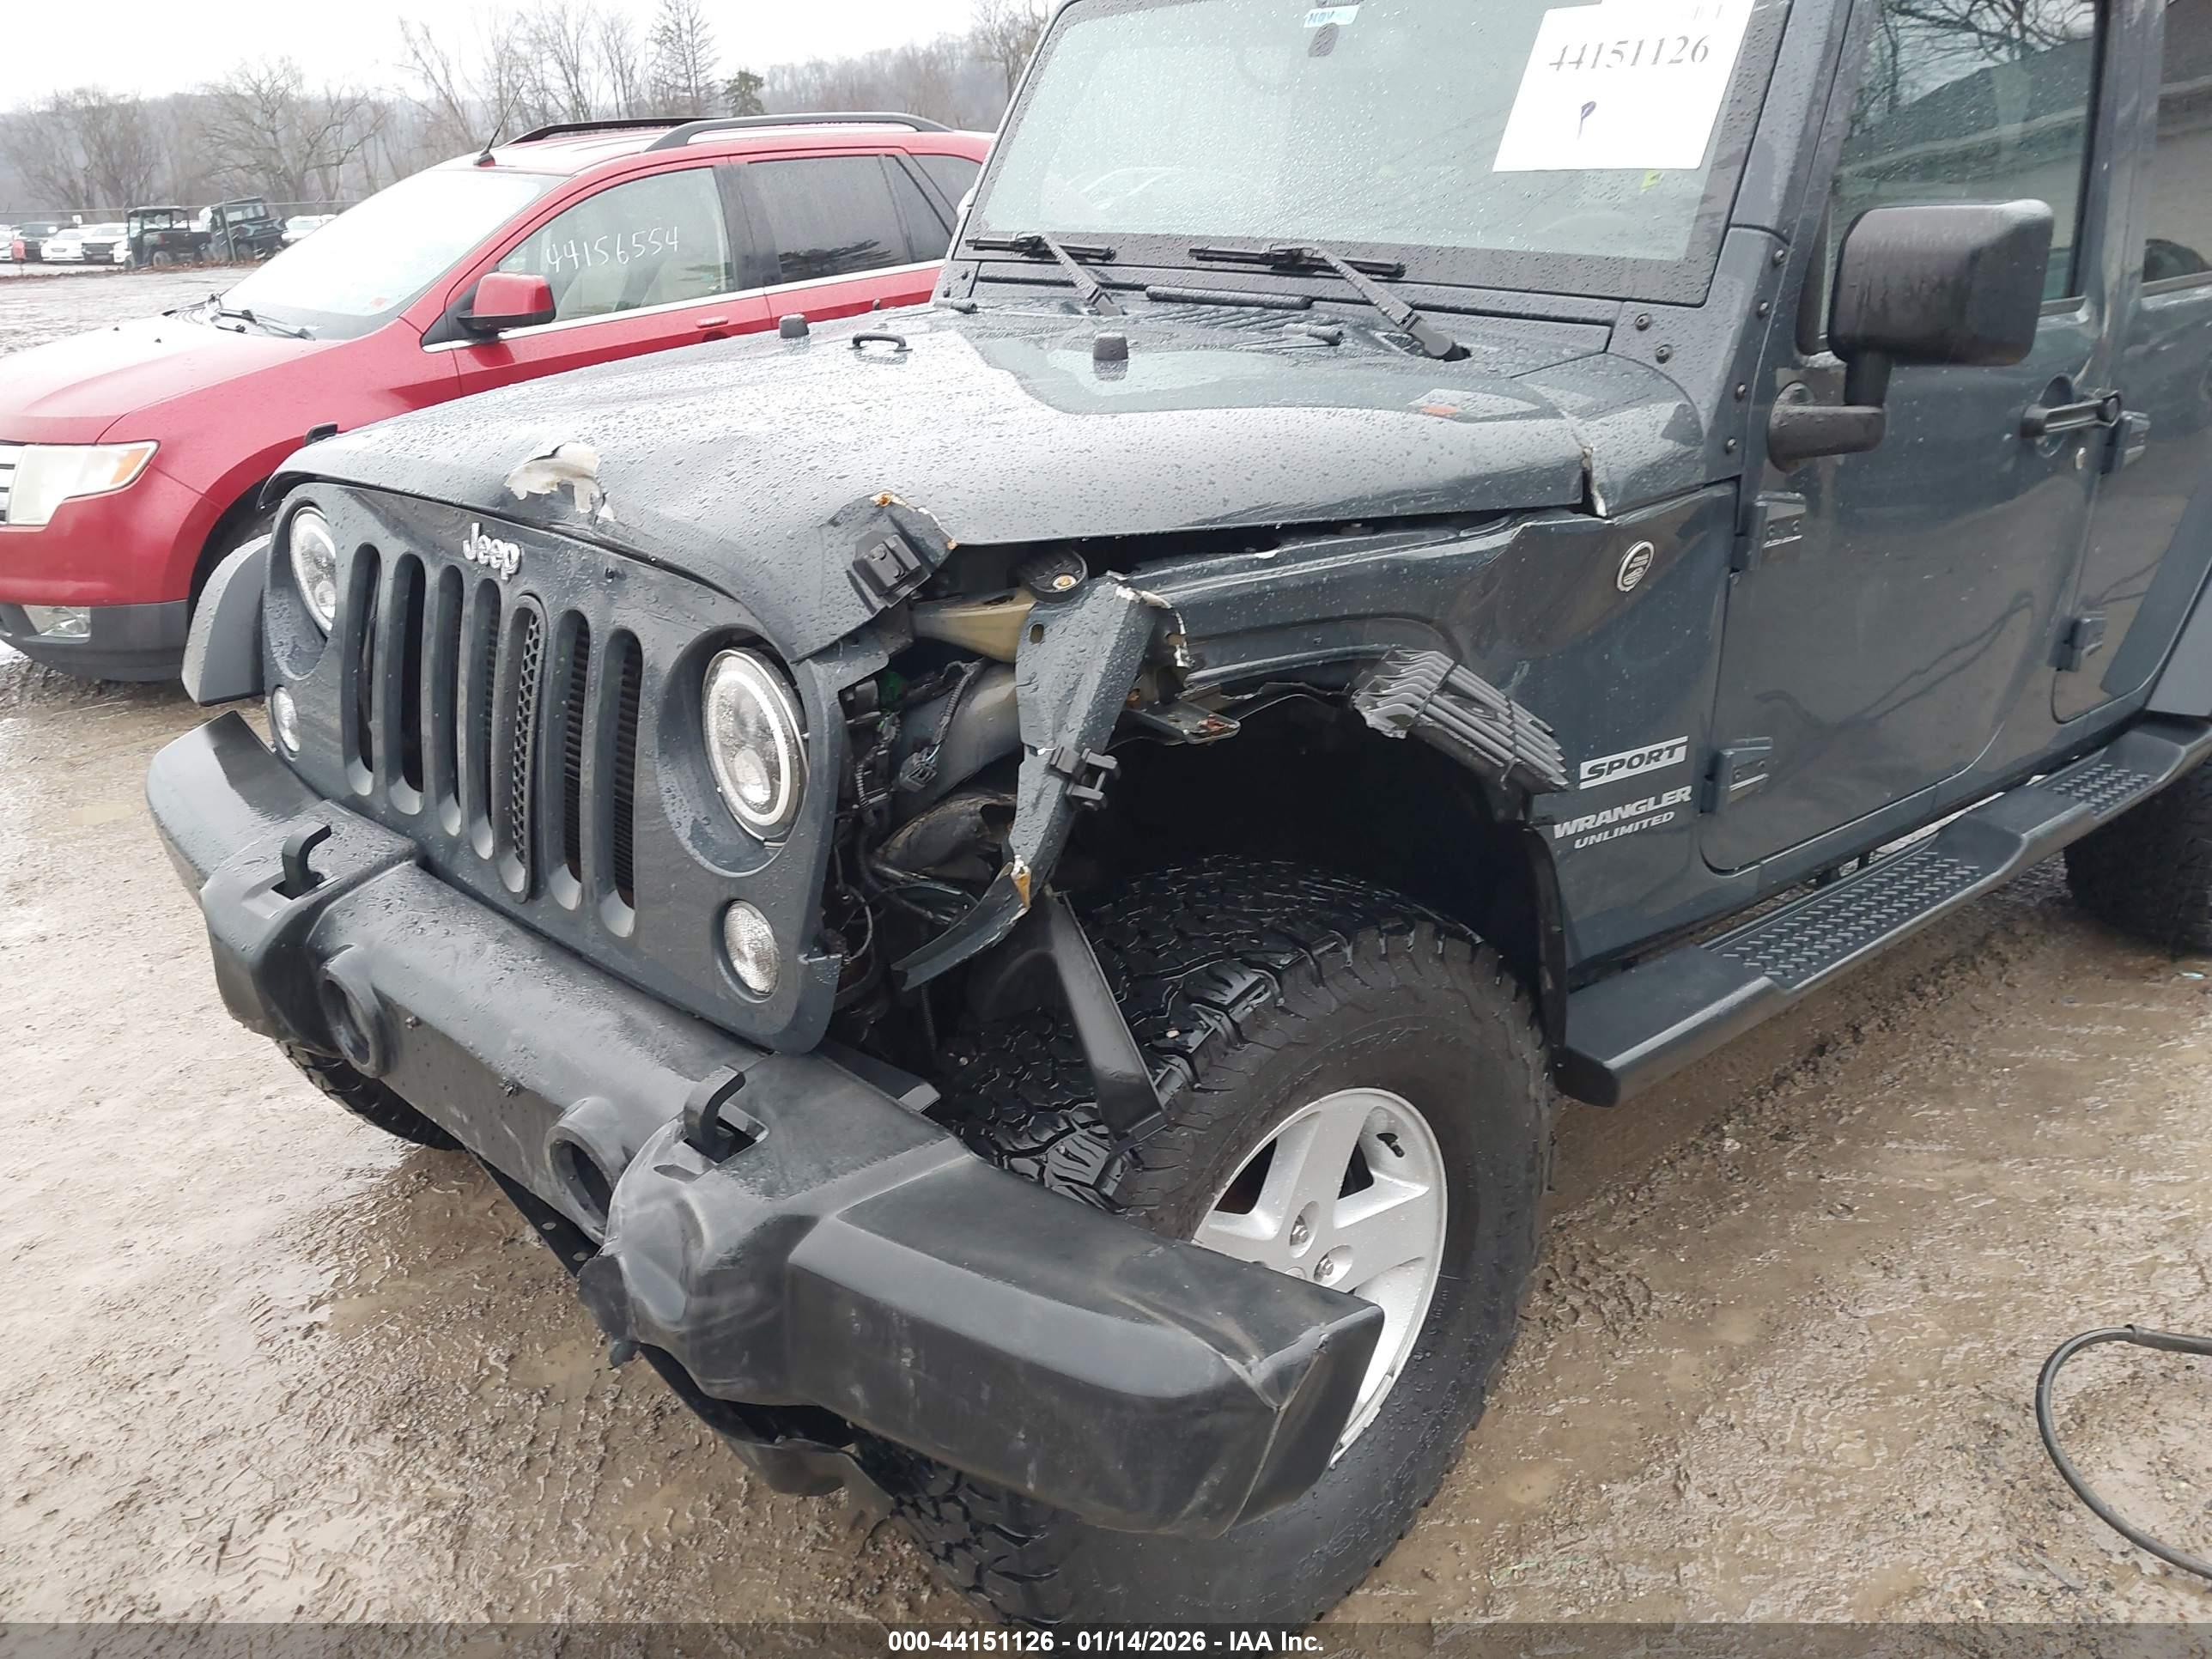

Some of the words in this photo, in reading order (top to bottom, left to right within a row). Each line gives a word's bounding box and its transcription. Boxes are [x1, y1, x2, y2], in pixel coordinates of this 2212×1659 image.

[1548, 34, 1711, 71] 44151126
[546, 226, 679, 273] 44156554
[462, 522, 520, 580] Jeep
[1584, 743, 1684, 781] SPORT
[1553, 785, 1692, 839] WRANGLER
[1574, 811, 1674, 849] UNLIMITED
